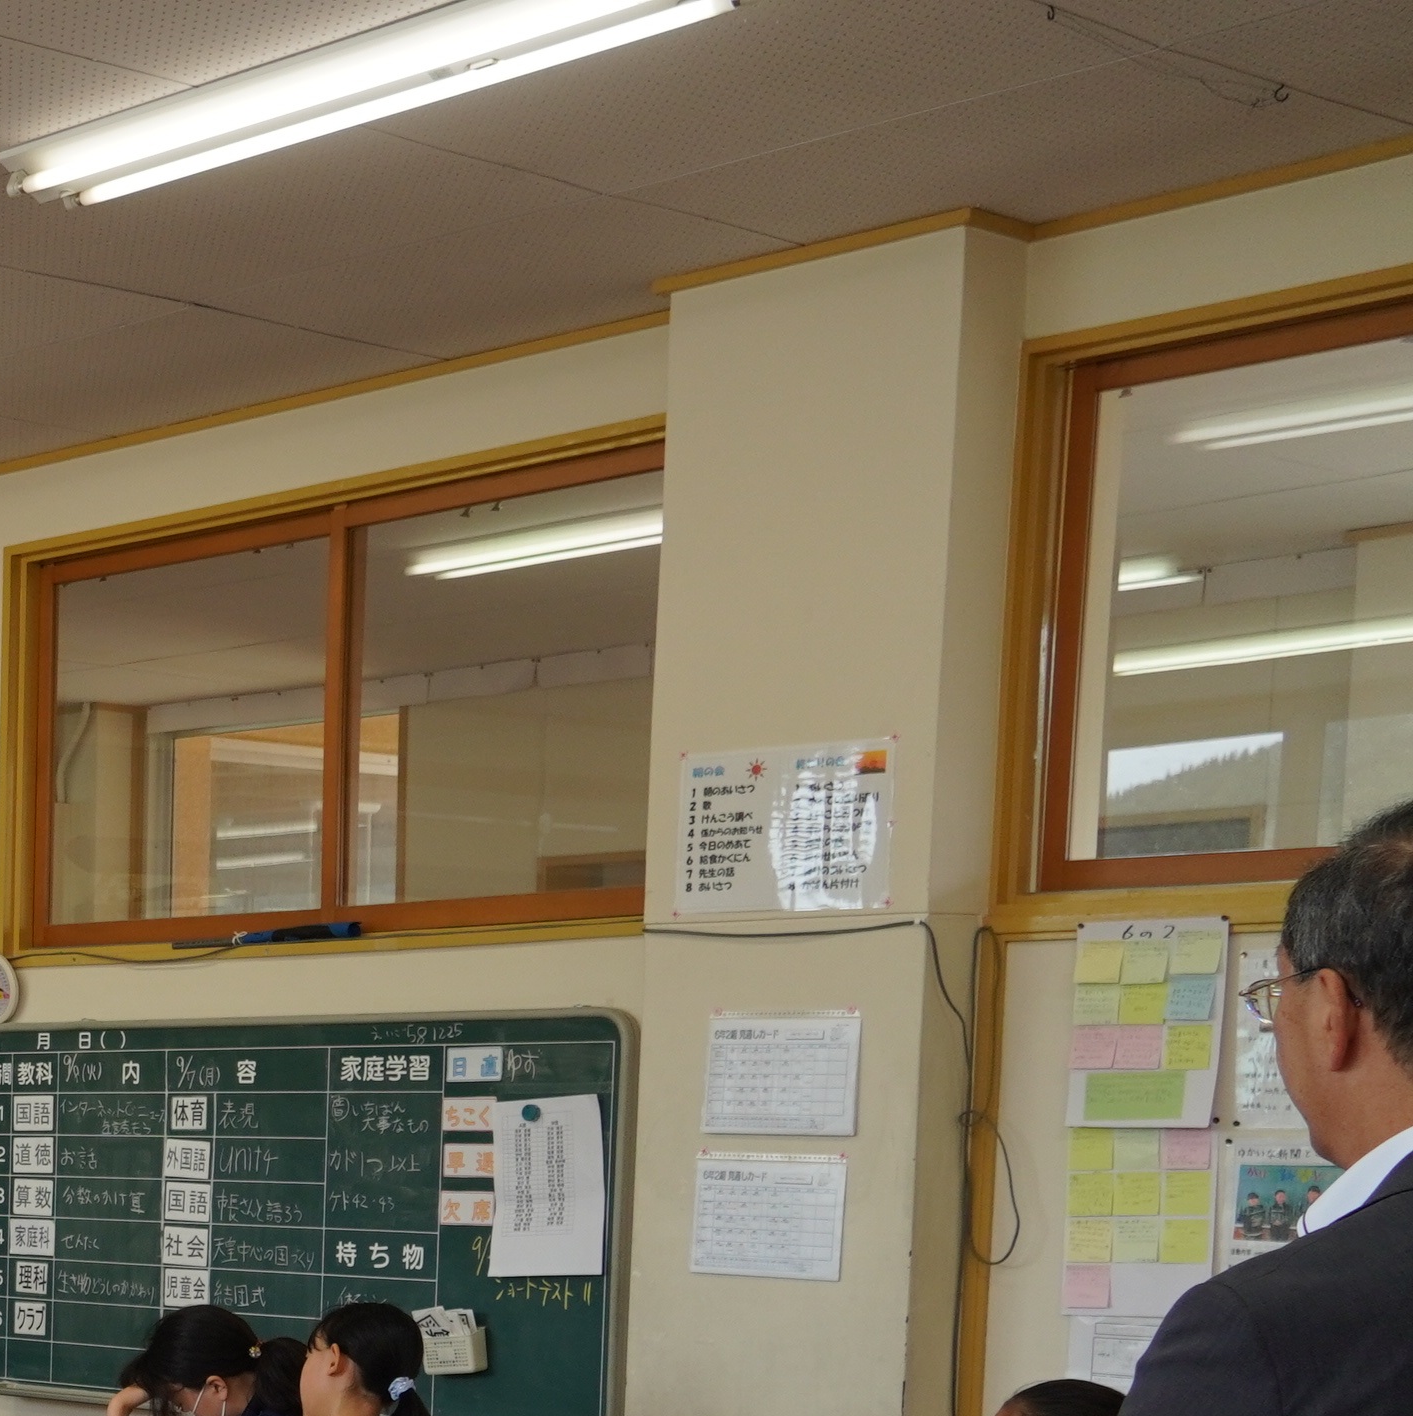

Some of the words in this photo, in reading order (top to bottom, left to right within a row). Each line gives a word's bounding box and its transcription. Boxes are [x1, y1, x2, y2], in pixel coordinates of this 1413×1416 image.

[691, 765, 726, 778] 朝の会
[702, 784, 755, 797] 朝のあいさつ
[688, 815, 696, 825] 3
[701, 811, 753, 824] けんこう調べ
[689, 802, 697, 812] 2
[686, 842, 694, 852] 5
[698, 839, 752, 851] 今日のめあて
[687, 828, 695, 838] 4
[686, 856, 694, 866] 6
[699, 852, 751, 865] 給食かくにん
[685, 869, 693, 879] 7
[698, 867, 736, 879] 先生の話
[685, 882, 693, 892] 8
[697, 881, 733, 892] あいさつ
[36, 1032, 51, 1050] 月
[17, 1061, 54, 1086] 教科
[121, 1060, 140, 1085] 内
[236, 1059, 257, 1085] 容
[340, 1054, 431, 1083] 家庭学習
[452, 1054, 500, 1078] 日直
[15, 1102, 51, 1125] 国語
[173, 1100, 205, 1127] 体育
[218, 1099, 259, 1130] 表現
[445, 1105, 490, 1128] ちこく
[15, 1143, 52, 1166] 道徳
[59, 1146, 99, 1170] お話
[166, 1145, 207, 1173] 外国語
[15, 1184, 52, 1209] 算数
[168, 1189, 208, 1215] 国語
[443, 1198, 492, 1223] 欠席
[14, 1224, 51, 1250] 家庭科
[165, 1233, 206, 1260] 社会
[335, 1240, 425, 1271] 持ち物
[18, 1264, 48, 1292] 理科
[166, 1275, 206, 1301] 児童会
[213, 1279, 267, 1308] 結団式
[16, 1305, 46, 1331] クラブ
